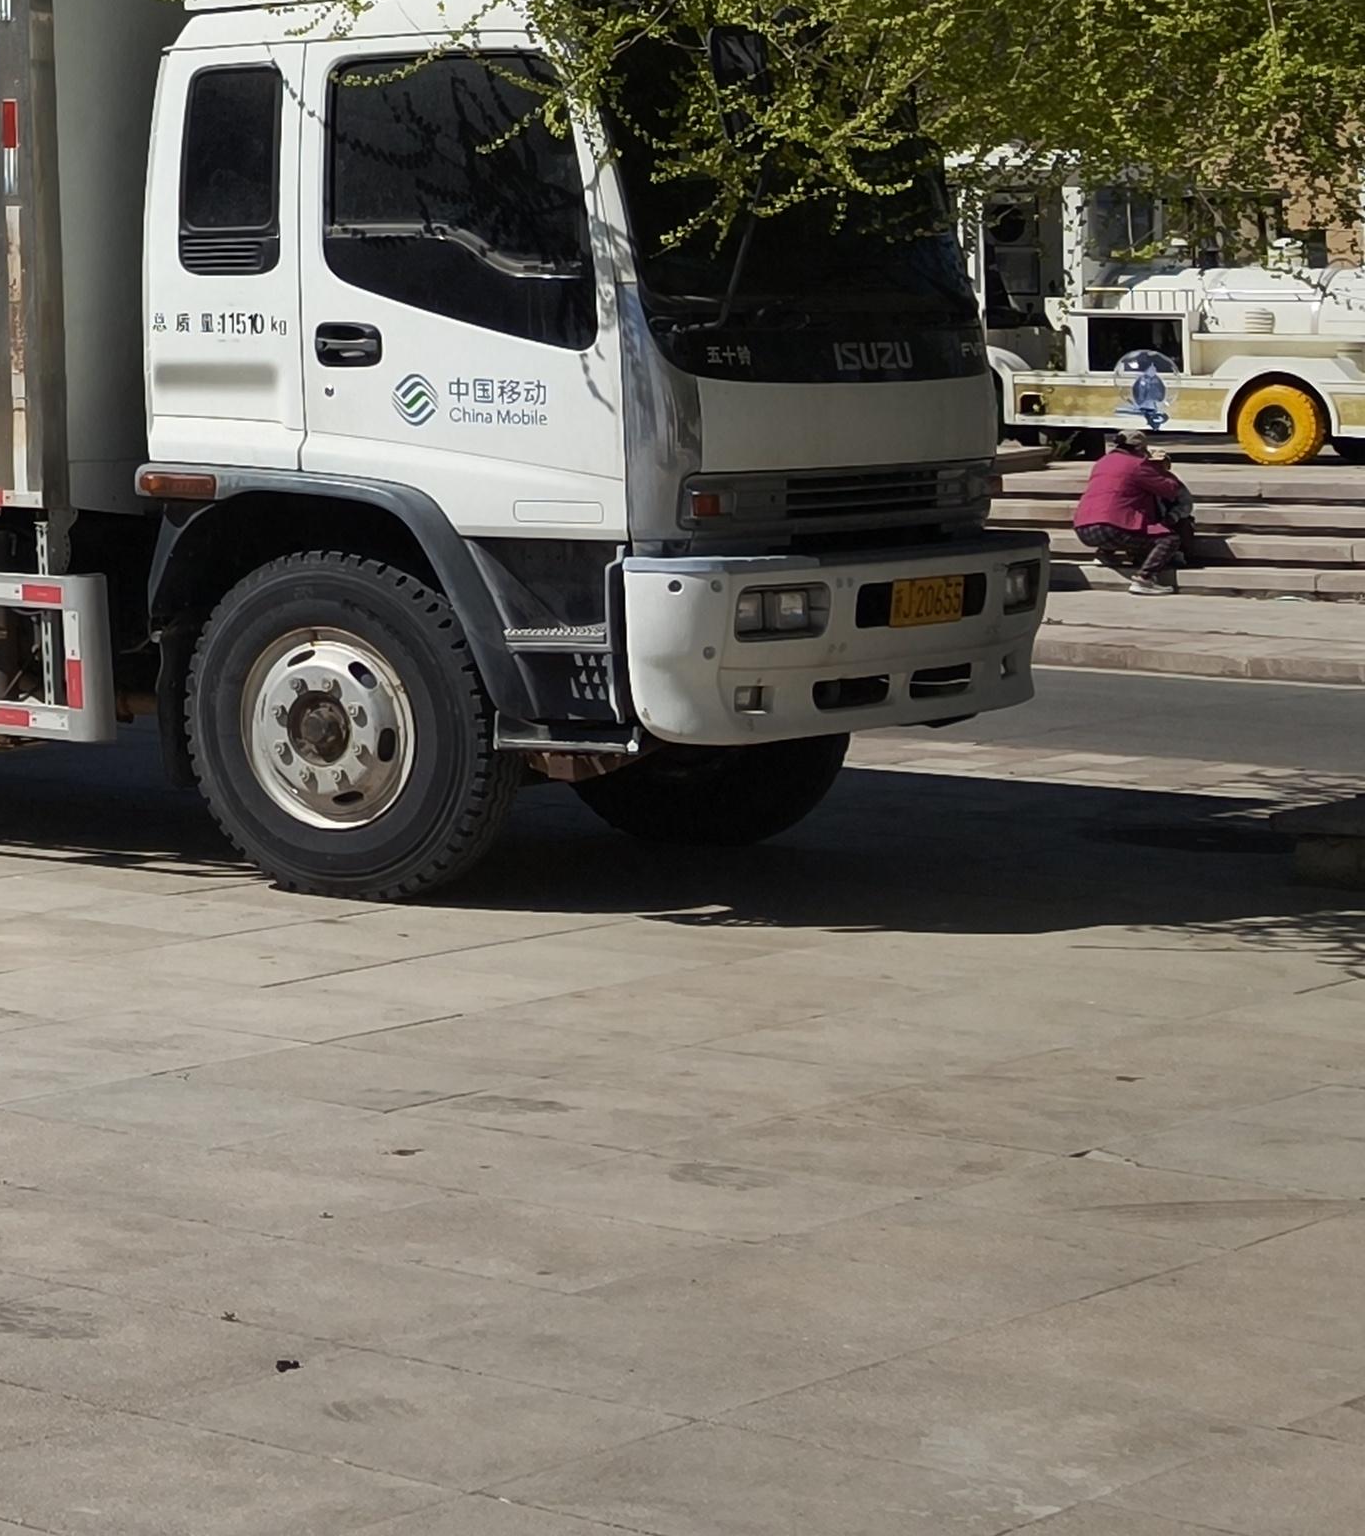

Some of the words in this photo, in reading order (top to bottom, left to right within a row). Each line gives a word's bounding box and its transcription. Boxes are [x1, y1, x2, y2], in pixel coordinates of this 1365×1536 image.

[706, 345, 752, 366] 五十铃
[832, 341, 914, 372] ISUZU
[448, 376, 547, 406] 中国移动
[448, 406, 493, 424] China
[496, 409, 548, 426] Mobile
